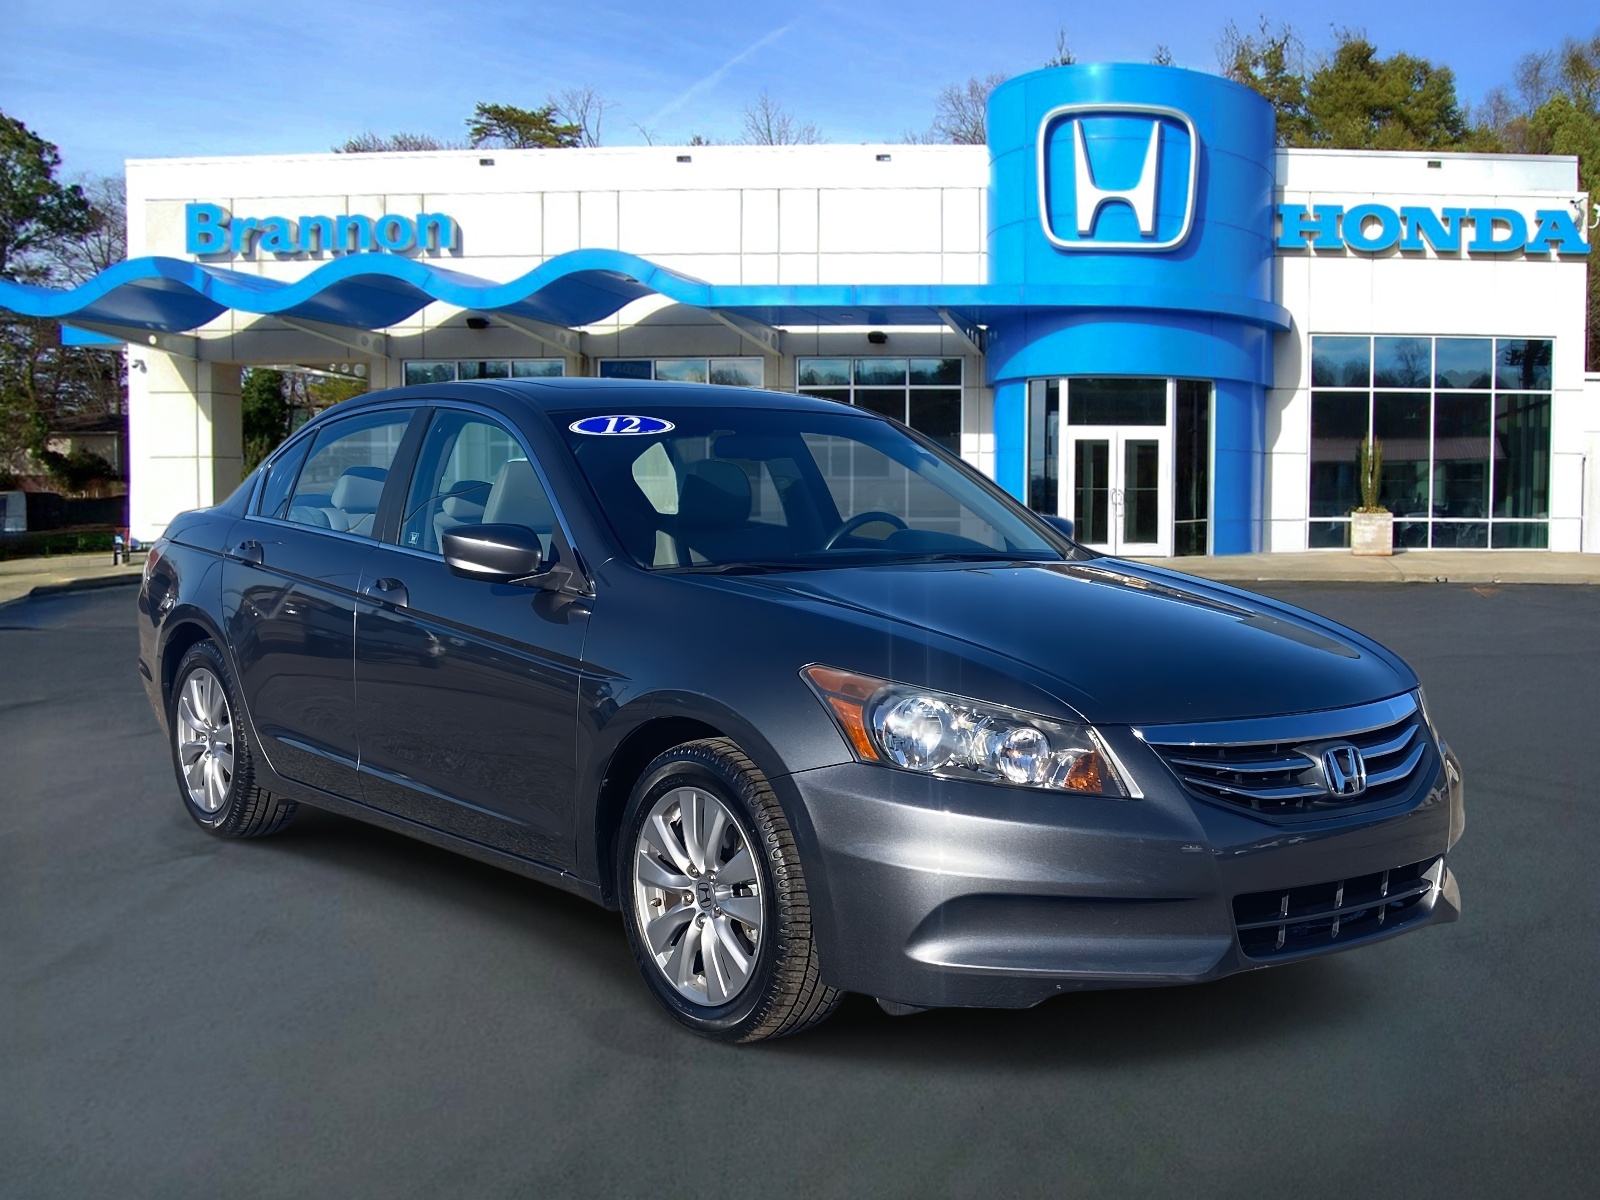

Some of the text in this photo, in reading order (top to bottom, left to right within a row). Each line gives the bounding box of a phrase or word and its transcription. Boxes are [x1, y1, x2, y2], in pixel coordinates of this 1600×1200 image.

[185, 202, 453, 255] Brannon
[1276, 203, 1592, 255] HONDA
[600, 416, 642, 434] 12
